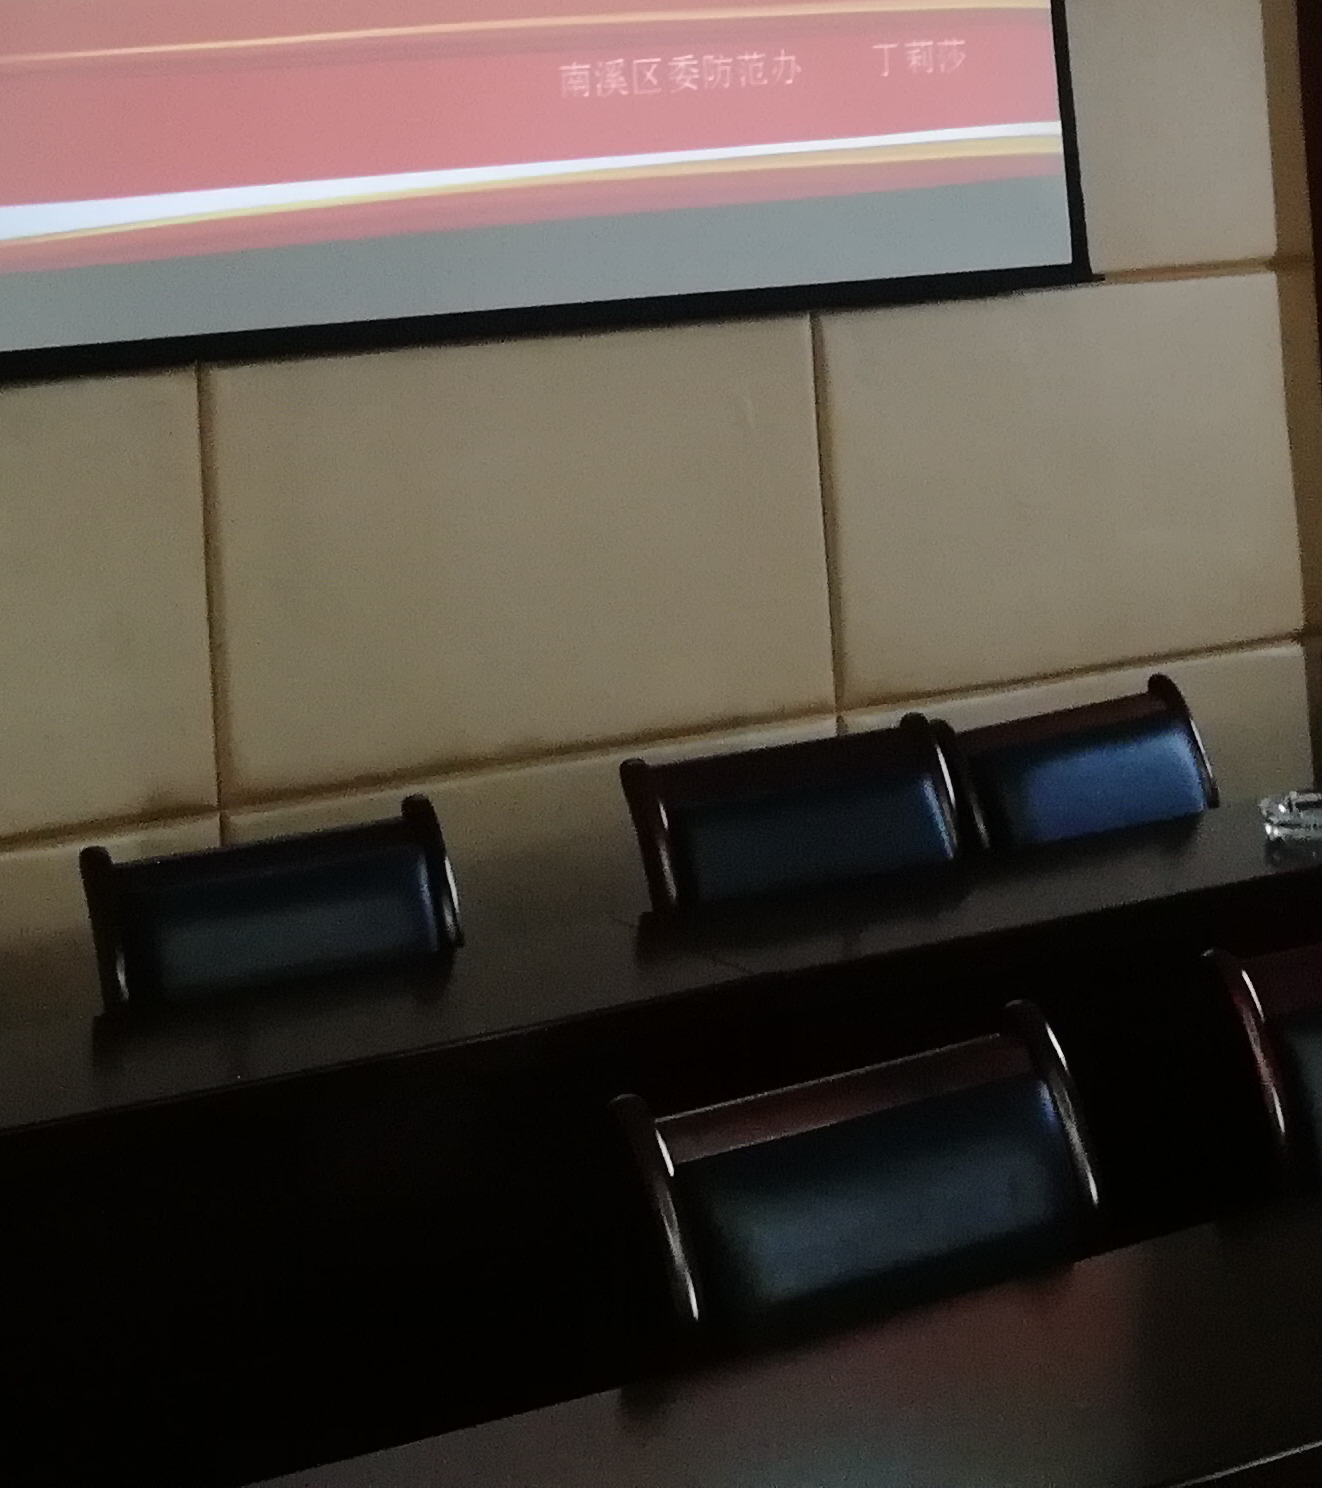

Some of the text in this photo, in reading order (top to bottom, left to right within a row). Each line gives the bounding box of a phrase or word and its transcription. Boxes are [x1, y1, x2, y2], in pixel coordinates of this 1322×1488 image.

[558, 48, 803, 98] 南溪区委防范办
